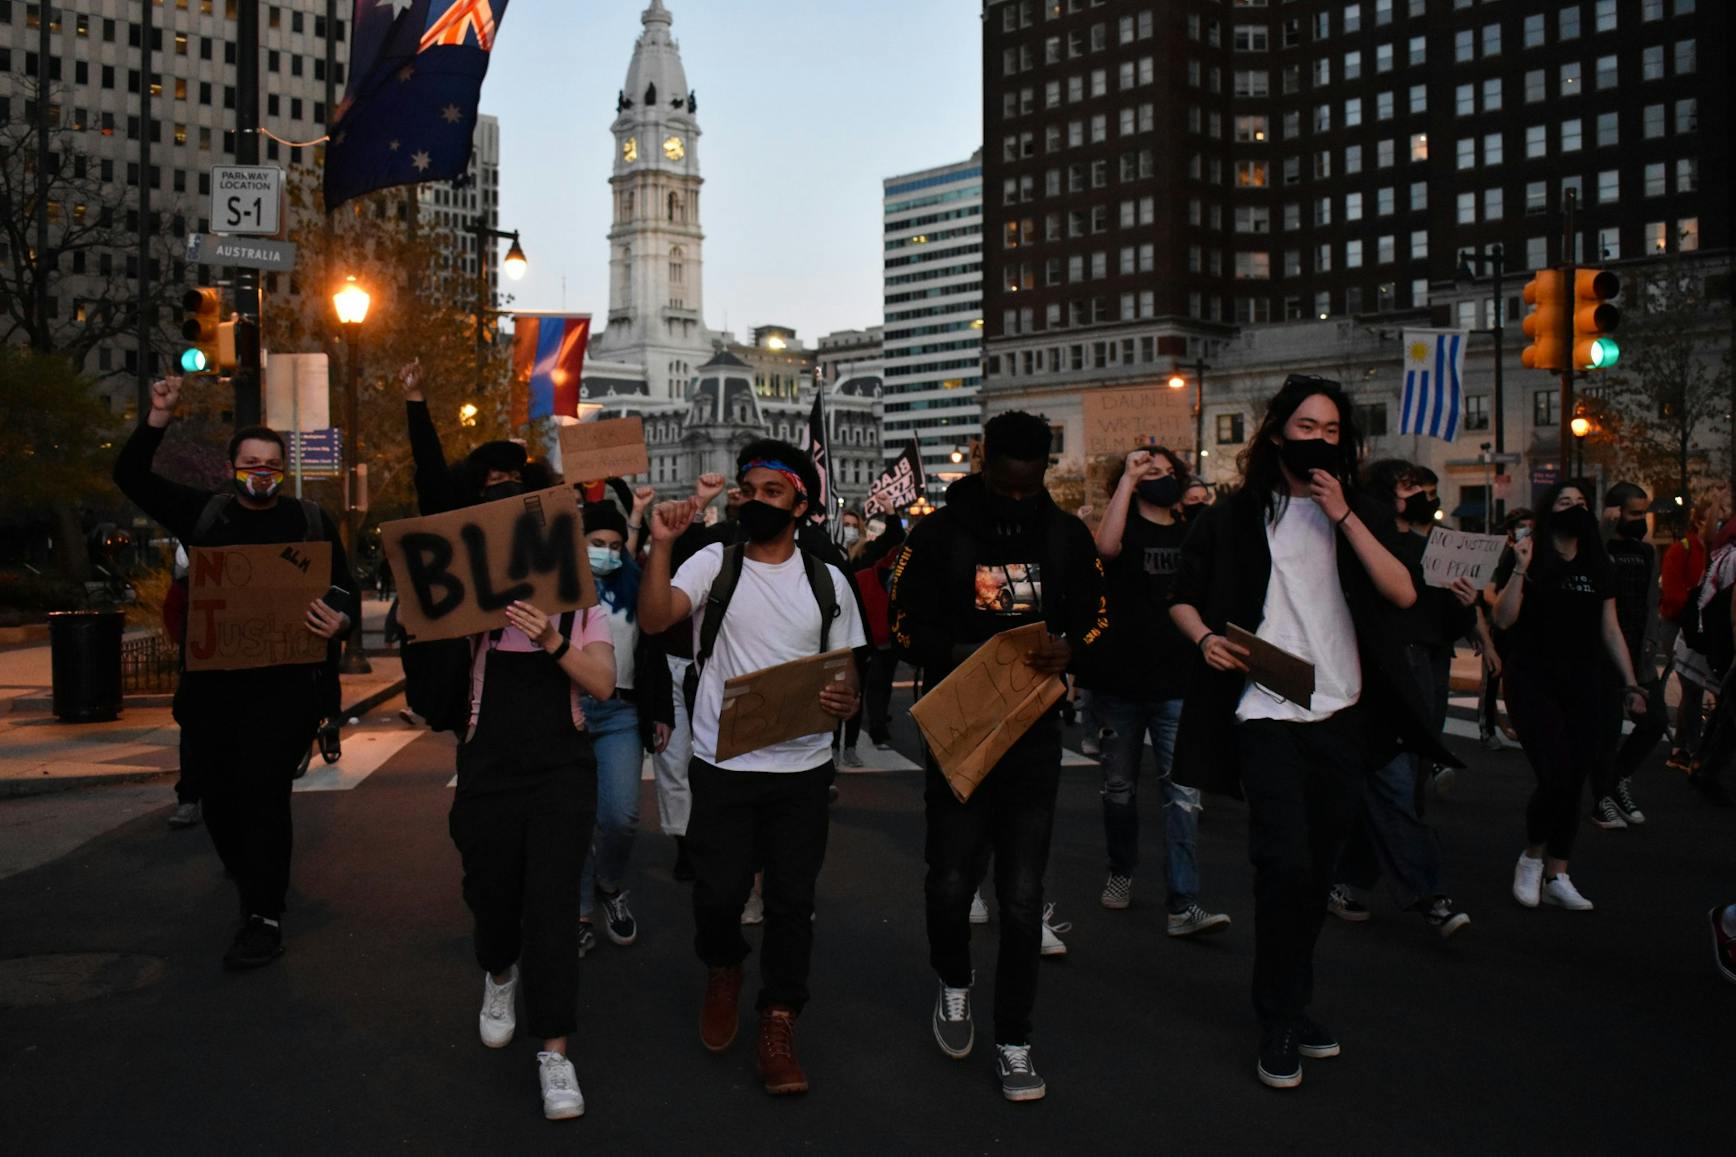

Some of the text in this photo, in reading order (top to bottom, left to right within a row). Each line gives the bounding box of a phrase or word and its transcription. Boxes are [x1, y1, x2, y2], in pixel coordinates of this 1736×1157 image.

[220, 181, 271, 190] LOCATION
[227, 196, 261, 226] S-1
[215, 245, 281, 262] AUSTRALIA
[1097, 415, 1183, 433] WRIGHT
[1430, 531, 1453, 548] NO
[193, 550, 253, 587] NO
[279, 545, 312, 575] BLM
[401, 513, 580, 621] BLM
